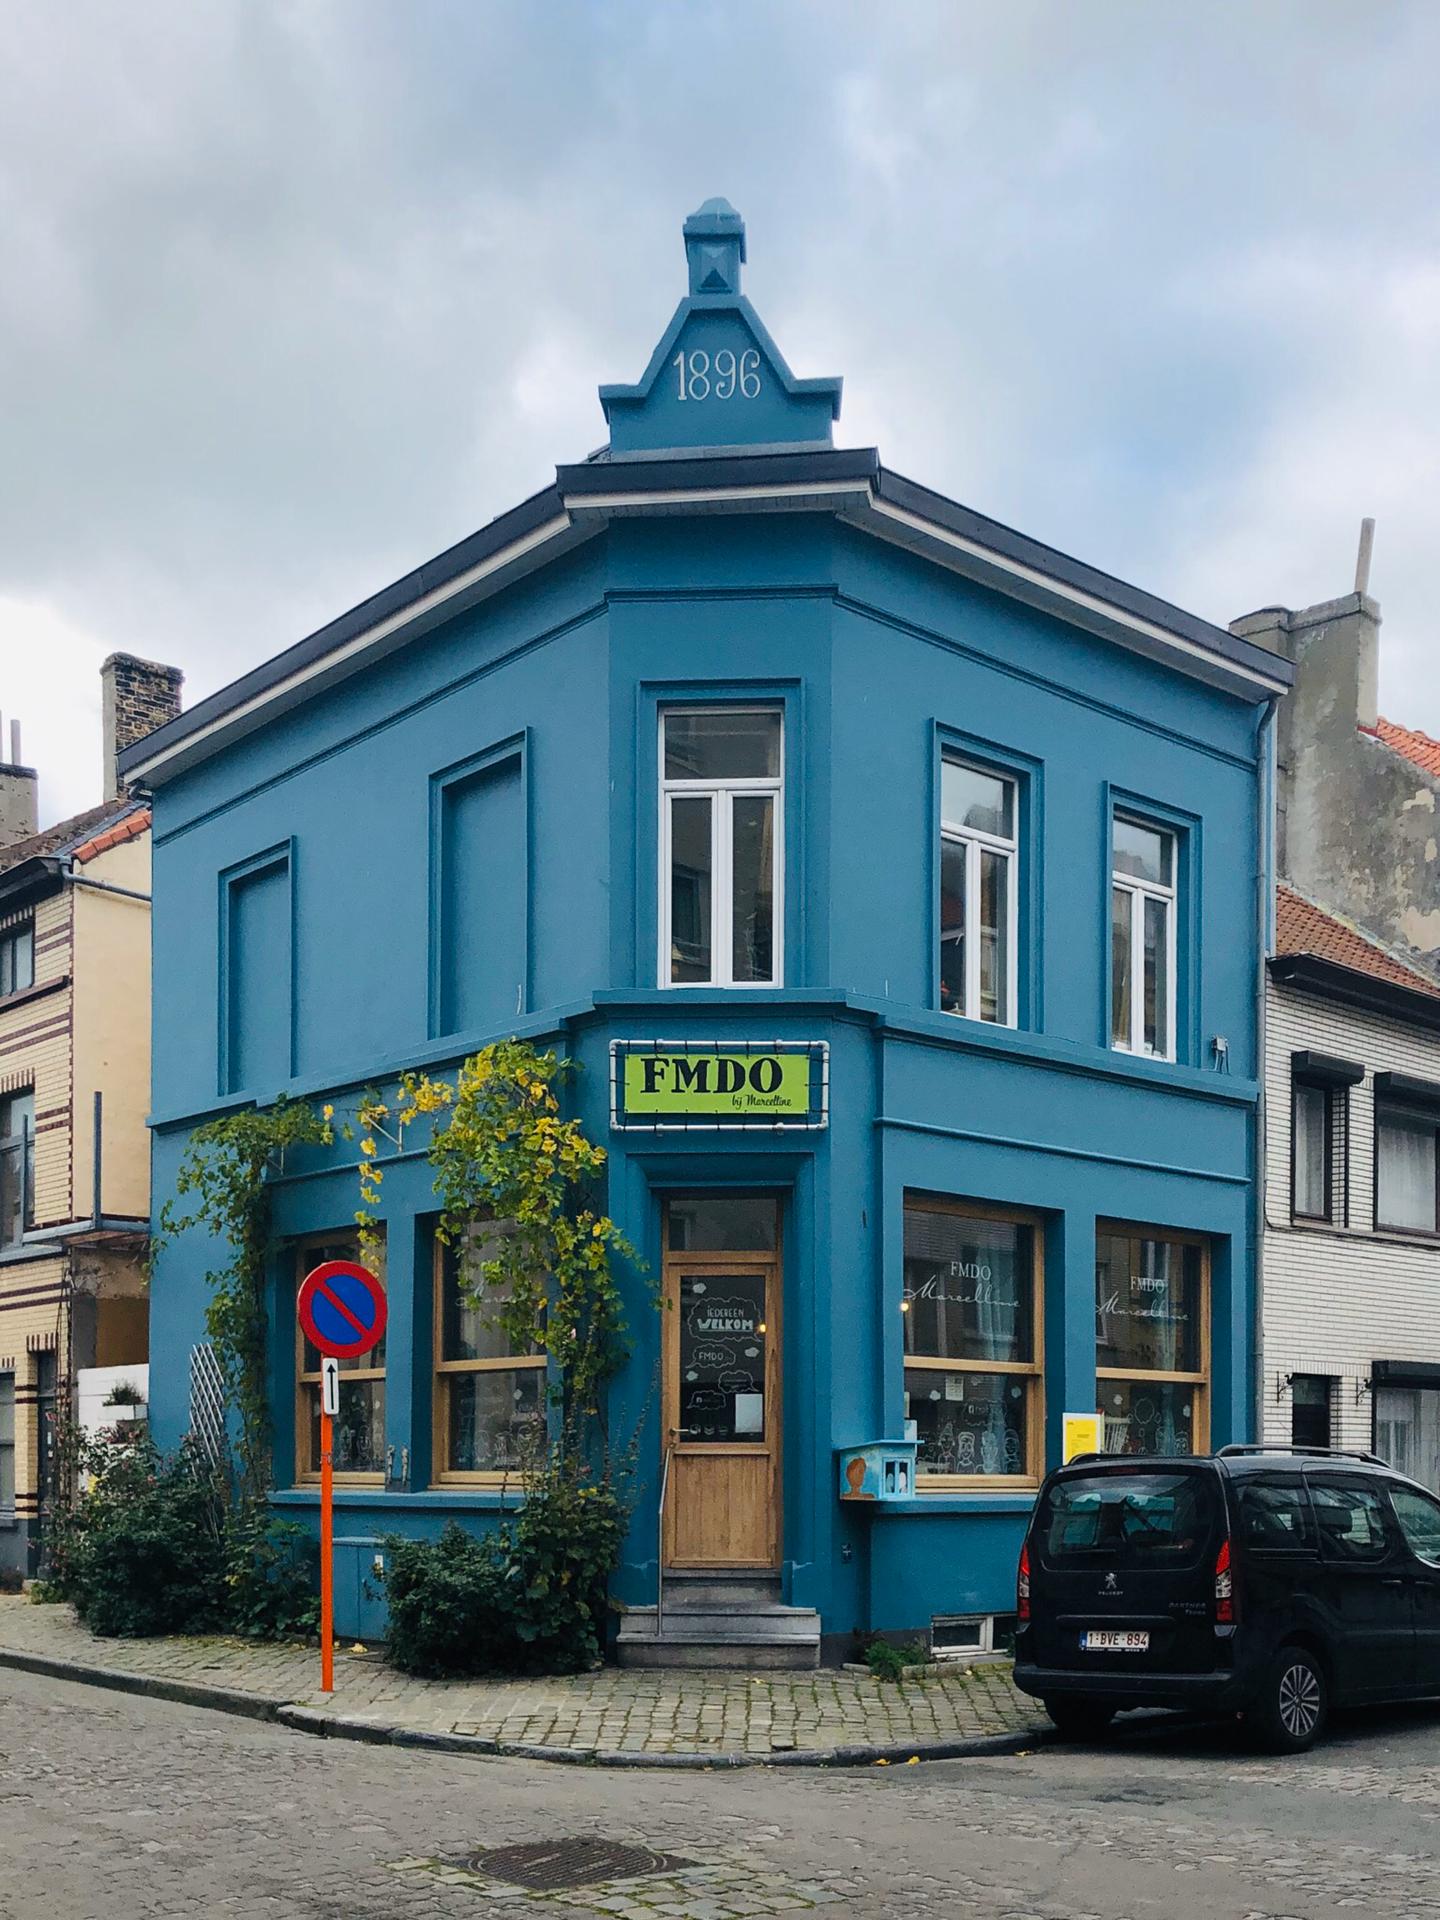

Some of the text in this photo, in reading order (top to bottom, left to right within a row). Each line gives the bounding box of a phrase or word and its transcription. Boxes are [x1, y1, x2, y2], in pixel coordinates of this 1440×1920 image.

[673, 349, 760, 400] 1896
[640, 1057, 783, 1093] FMDO
[951, 1261, 992, 1281] FMDO
[903, 1274, 1020, 1307] Marcelline
[1130, 1275, 1165, 1294] FMDO
[697, 1318, 754, 1331] WELKOM
